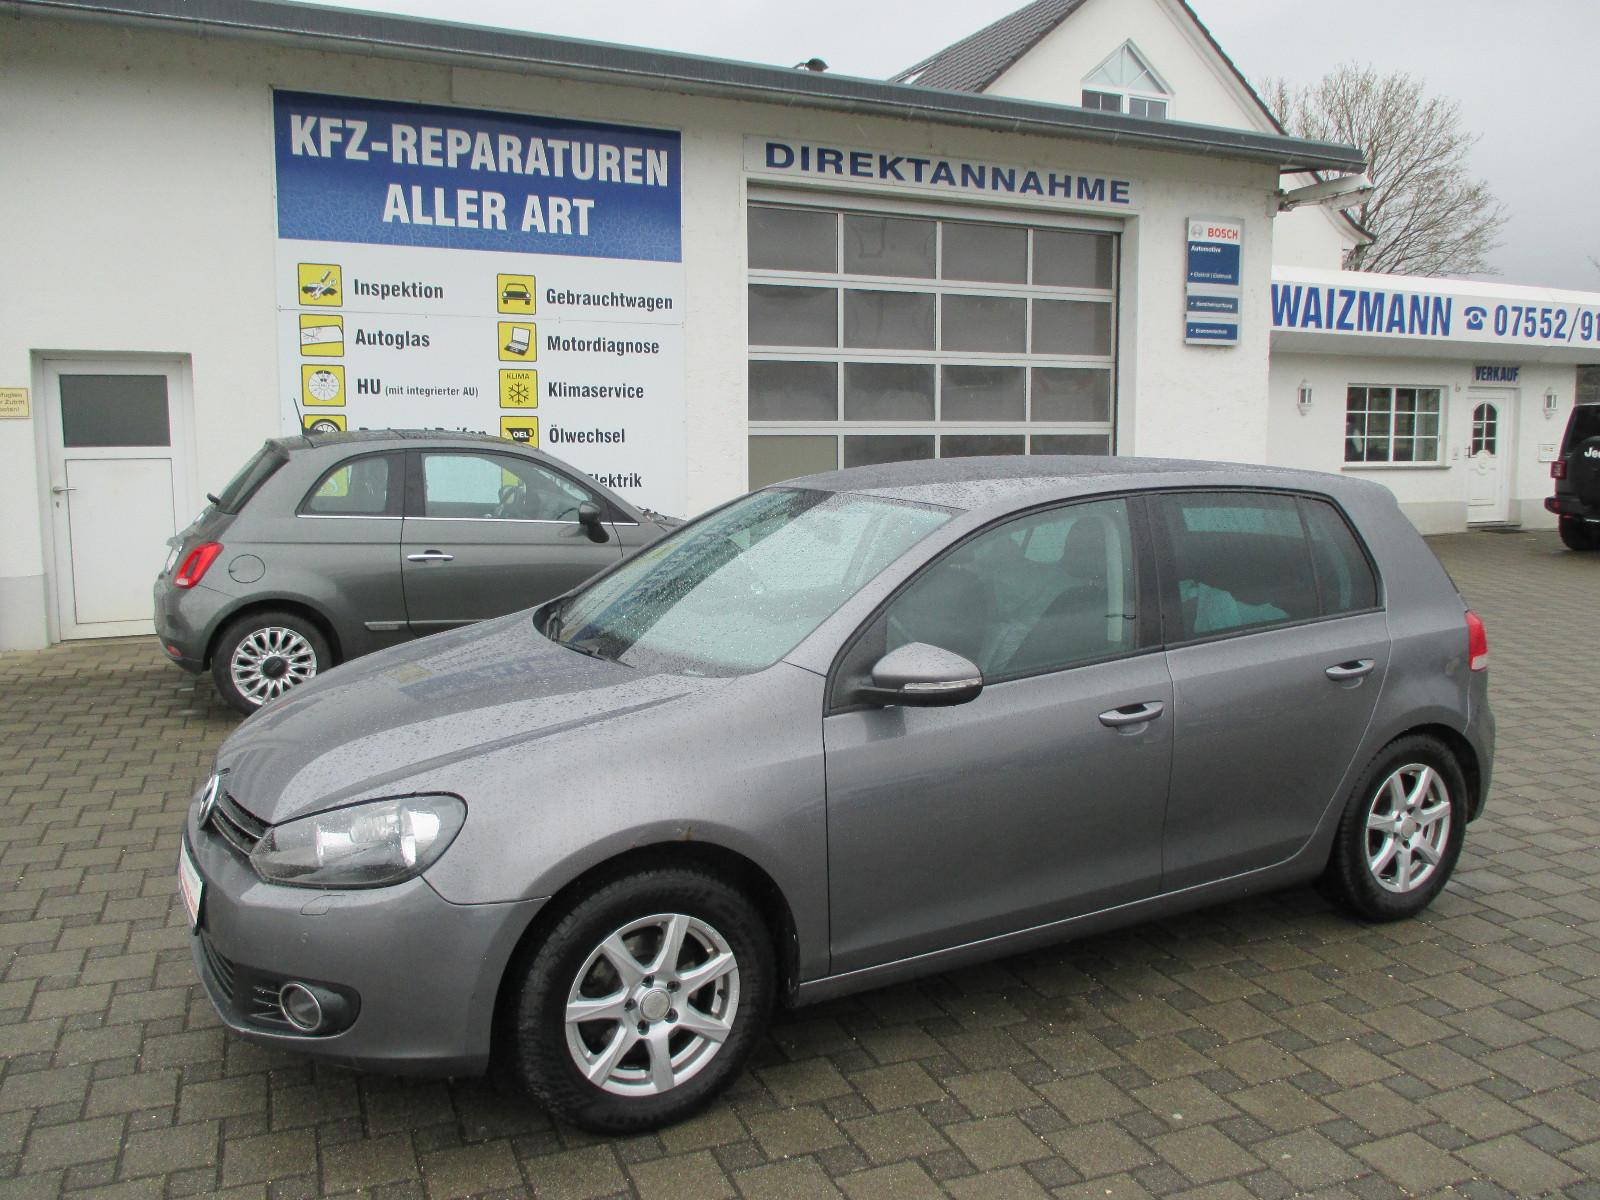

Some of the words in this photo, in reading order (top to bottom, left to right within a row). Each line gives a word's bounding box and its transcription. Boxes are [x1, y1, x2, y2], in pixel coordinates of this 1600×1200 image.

[289, 114, 669, 187] KFZ-REPARATUREN
[765, 141, 1130, 205] DIREKTANNAHME
[382, 183, 508, 231] ALLER
[520, 194, 595, 236] ART
[1207, 228, 1238, 240] BOSCH
[1190, 245, 1222, 253] Automotive
[353, 279, 444, 301] Inspektion
[546, 288, 674, 312] Gebrauchtwagen
[1270, 283, 1453, 337] WAIZMANN
[355, 329, 431, 350] Autoglas
[547, 335, 660, 356] Motordiagnose
[1475, 366, 1521, 382] VERKAUF
[357, 378, 381, 395] HU
[385, 385, 404, 397] (mit
[406, 385, 461, 398] integrierter
[463, 386, 479, 398] AU)
[548, 381, 644, 399] Klimaservice
[549, 424, 626, 444] Ölwechsel
[1584, 446, 1600, 459] Je
[588, 472, 643, 488] ektrik
